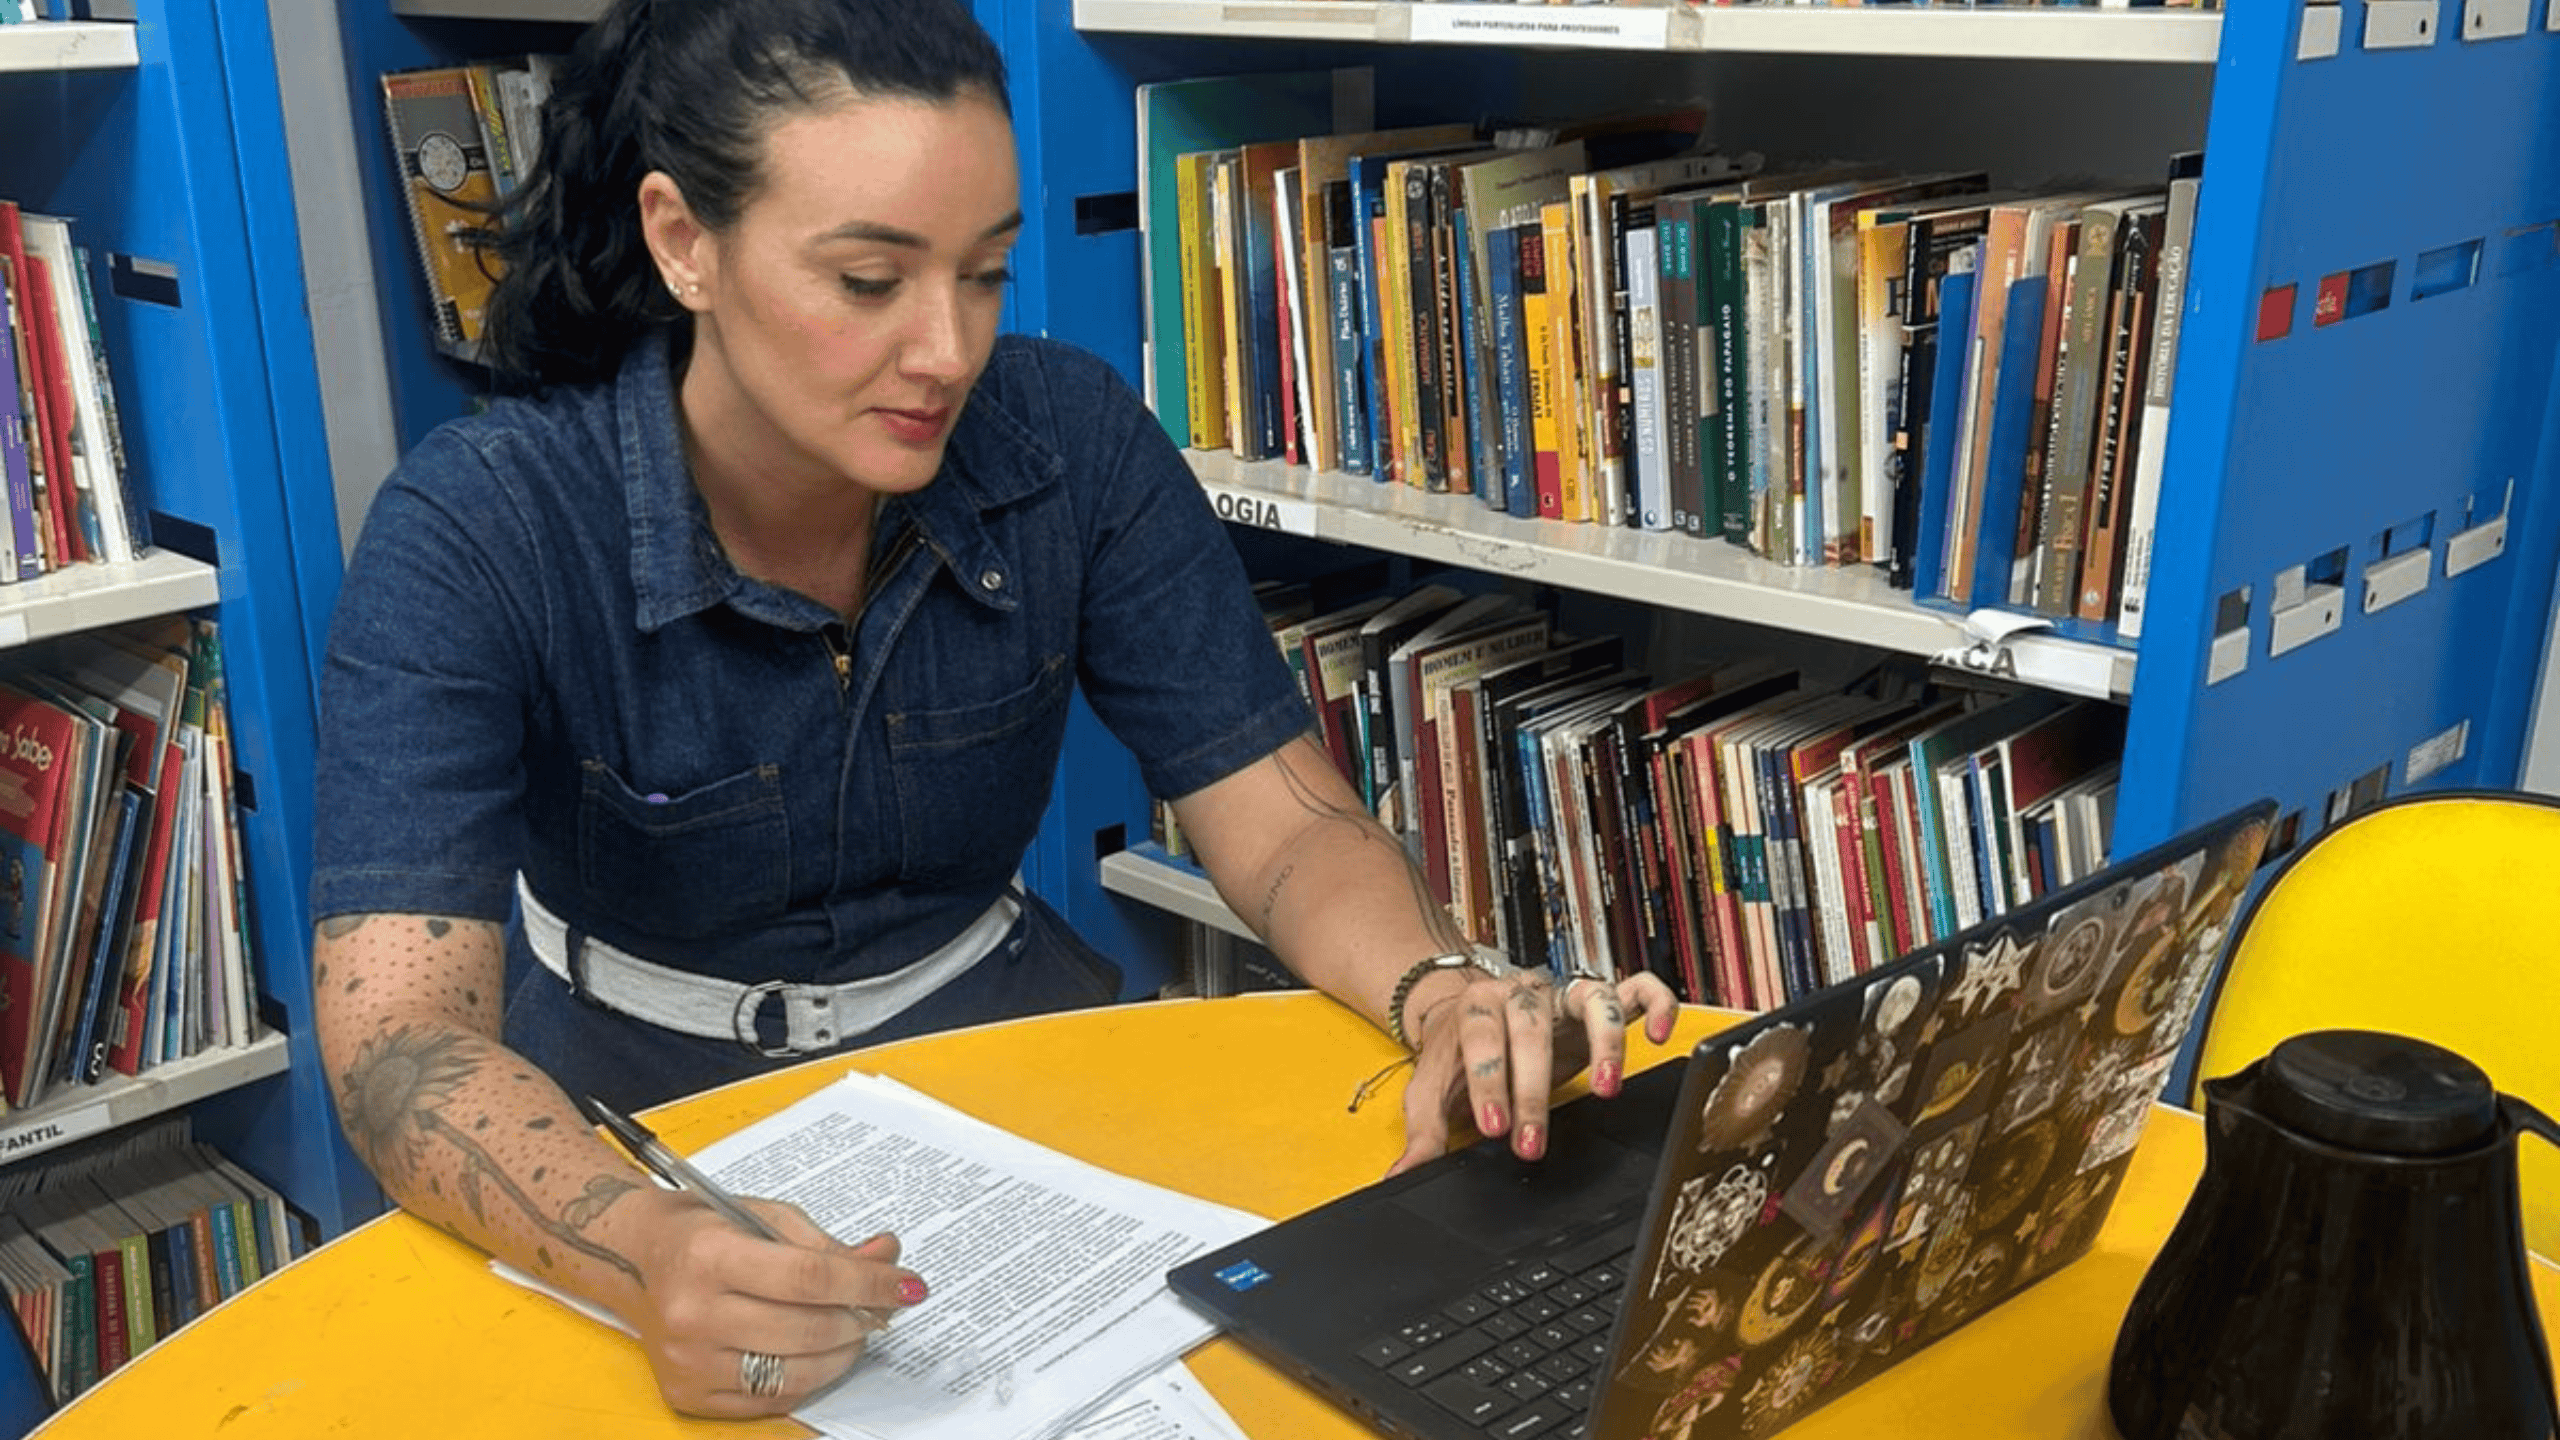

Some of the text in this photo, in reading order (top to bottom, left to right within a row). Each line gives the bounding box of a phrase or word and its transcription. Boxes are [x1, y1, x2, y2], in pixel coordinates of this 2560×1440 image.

[1497, 294, 1514, 384] Malba Tahan
[2117, 324, 2129, 336] A
[2151, 245, 2184, 397] HISTÓRIA DA EDUCAÇÃO
[1722, 304, 1735, 481] O TEOREMA DO PAPAGAIO
[2110, 348, 2127, 394] Vida
[2096, 436, 2116, 501] Limite
